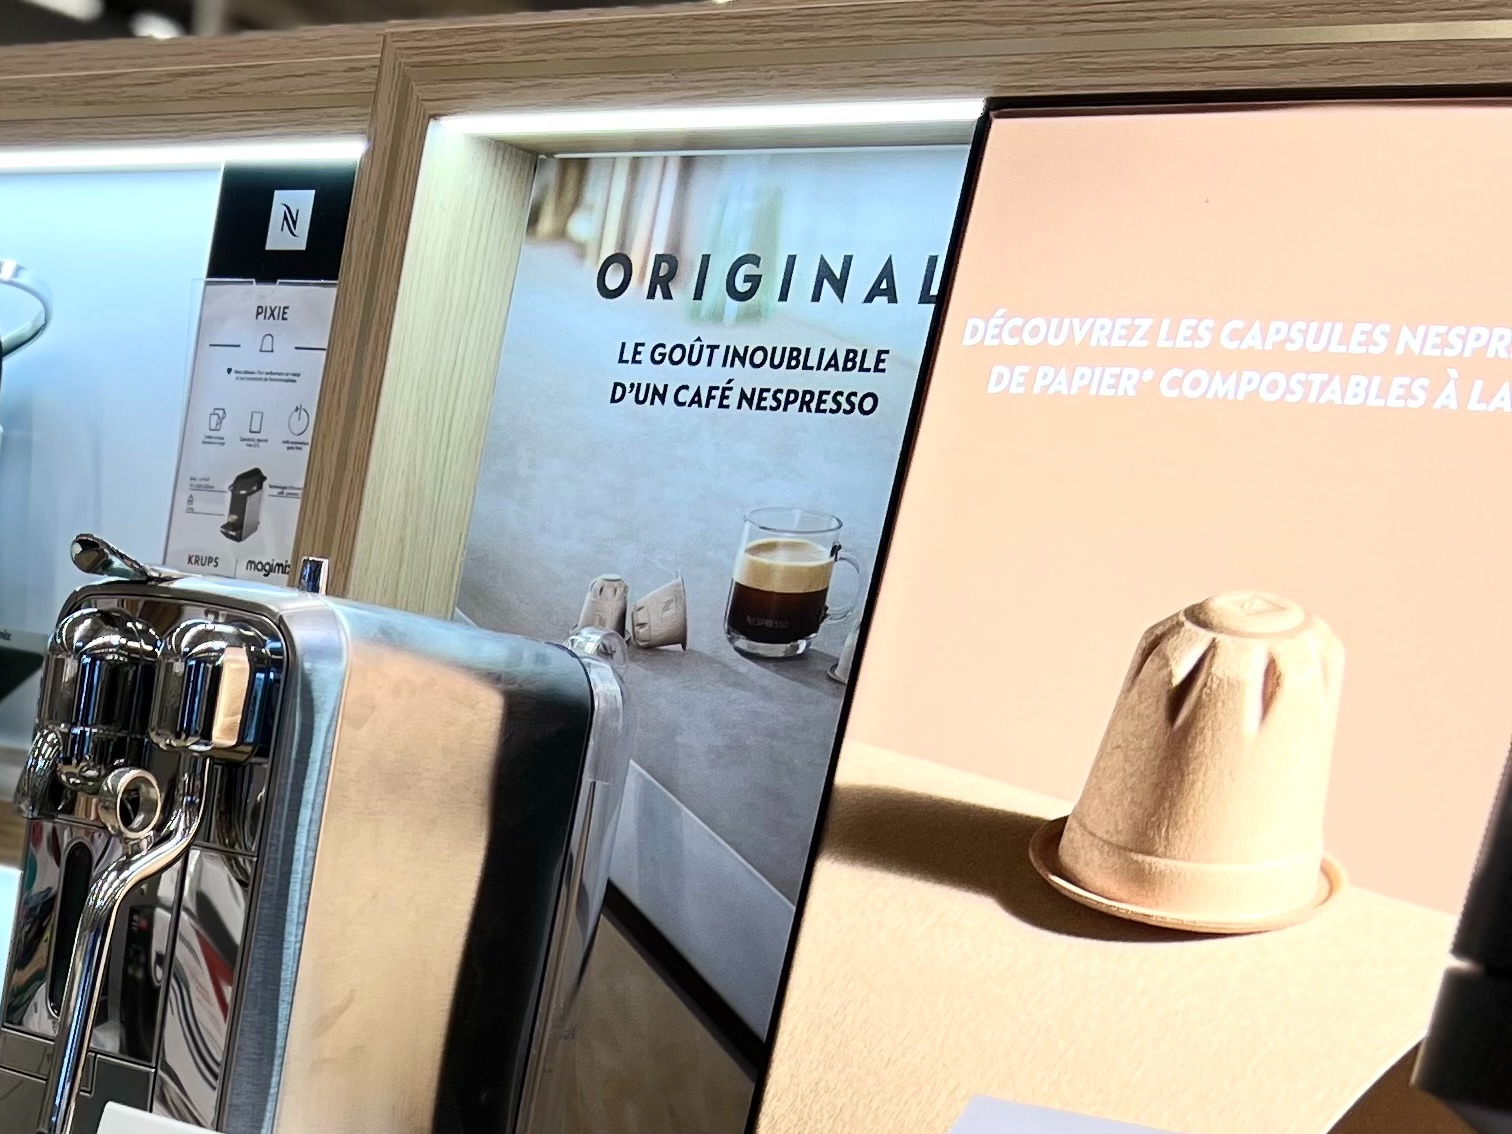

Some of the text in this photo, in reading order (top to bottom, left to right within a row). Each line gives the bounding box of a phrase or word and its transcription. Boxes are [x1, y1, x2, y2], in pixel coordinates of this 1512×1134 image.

[595, 252, 939, 305] ORIGINAL
[255, 304, 290, 321] PIXIE
[961, 308, 1512, 359] DÉCOUVREZ LES CAPSULES NESPR
[617, 335, 890, 373] LE GOÛT INOUBLIABLE
[609, 378, 880, 416] D'UN CAFÉ NESPRESSO
[987, 364, 1031, 395] DE
[1158, 367, 1430, 409] COMPOSTABLES
[1431, 367, 1459, 410] À
[1467, 379, 1512, 413] LA
[187, 554, 220, 568] KRUPS
